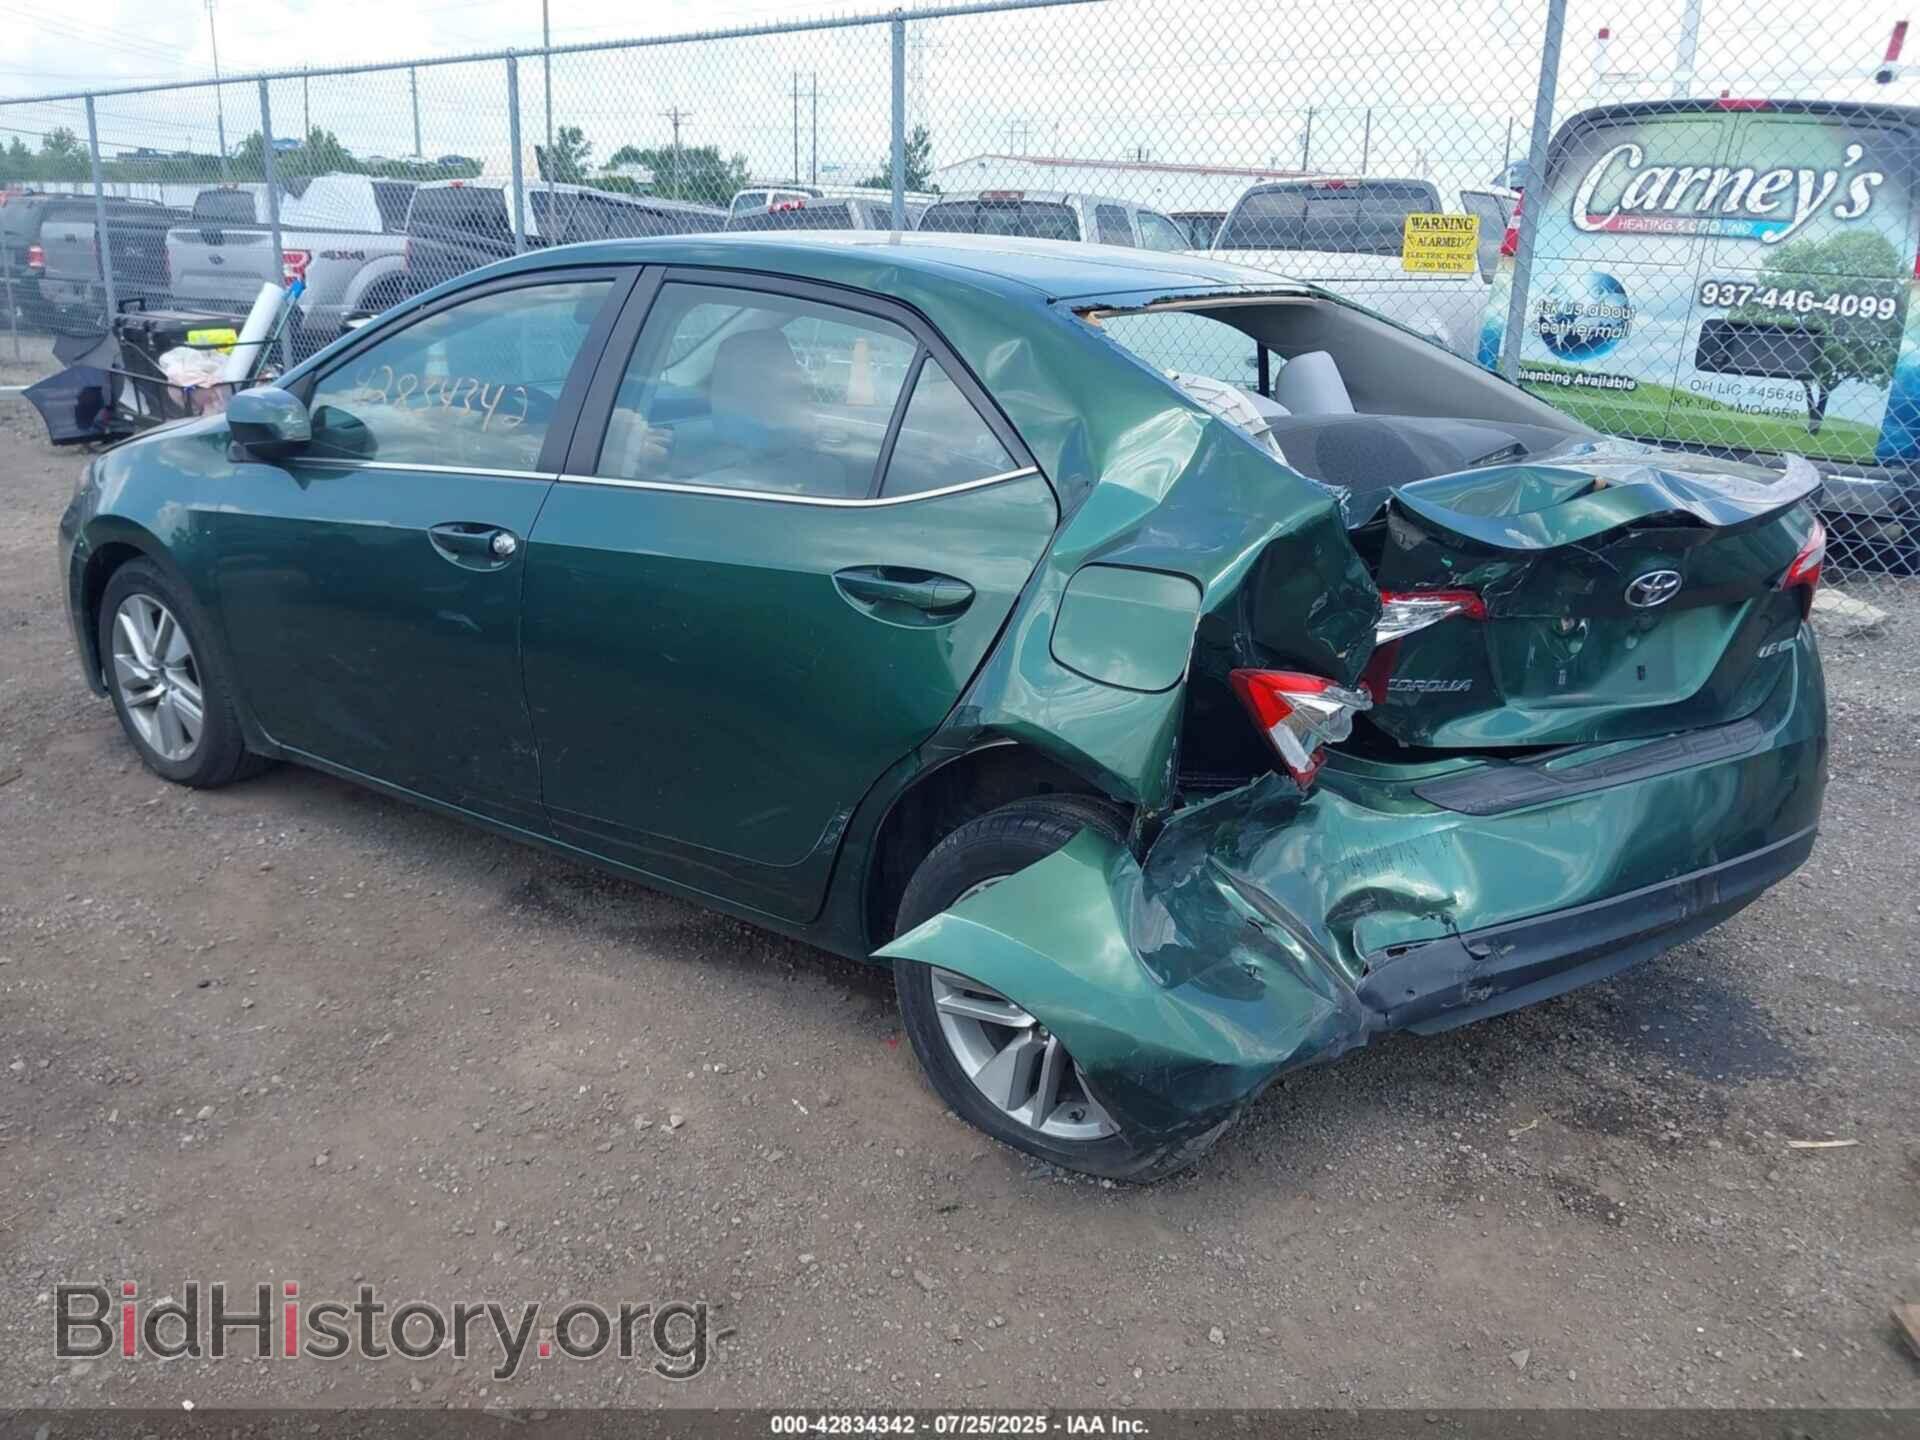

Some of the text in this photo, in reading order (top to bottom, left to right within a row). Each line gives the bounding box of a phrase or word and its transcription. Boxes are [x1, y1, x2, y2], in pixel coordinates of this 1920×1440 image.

[1572, 143, 1885, 243] Carney's
[1411, 216, 1474, 230] WARNING
[1618, 217, 1673, 232] HEATING
[1534, 299, 1637, 319] Ask us about
[1701, 282, 1897, 320] 937-446-4099
[1519, 367, 1637, 390] inancing Available
[1690, 379, 1713, 392] OH
[355, 364, 528, 432] 42834342
[1387, 678, 1472, 692] COROLLA
